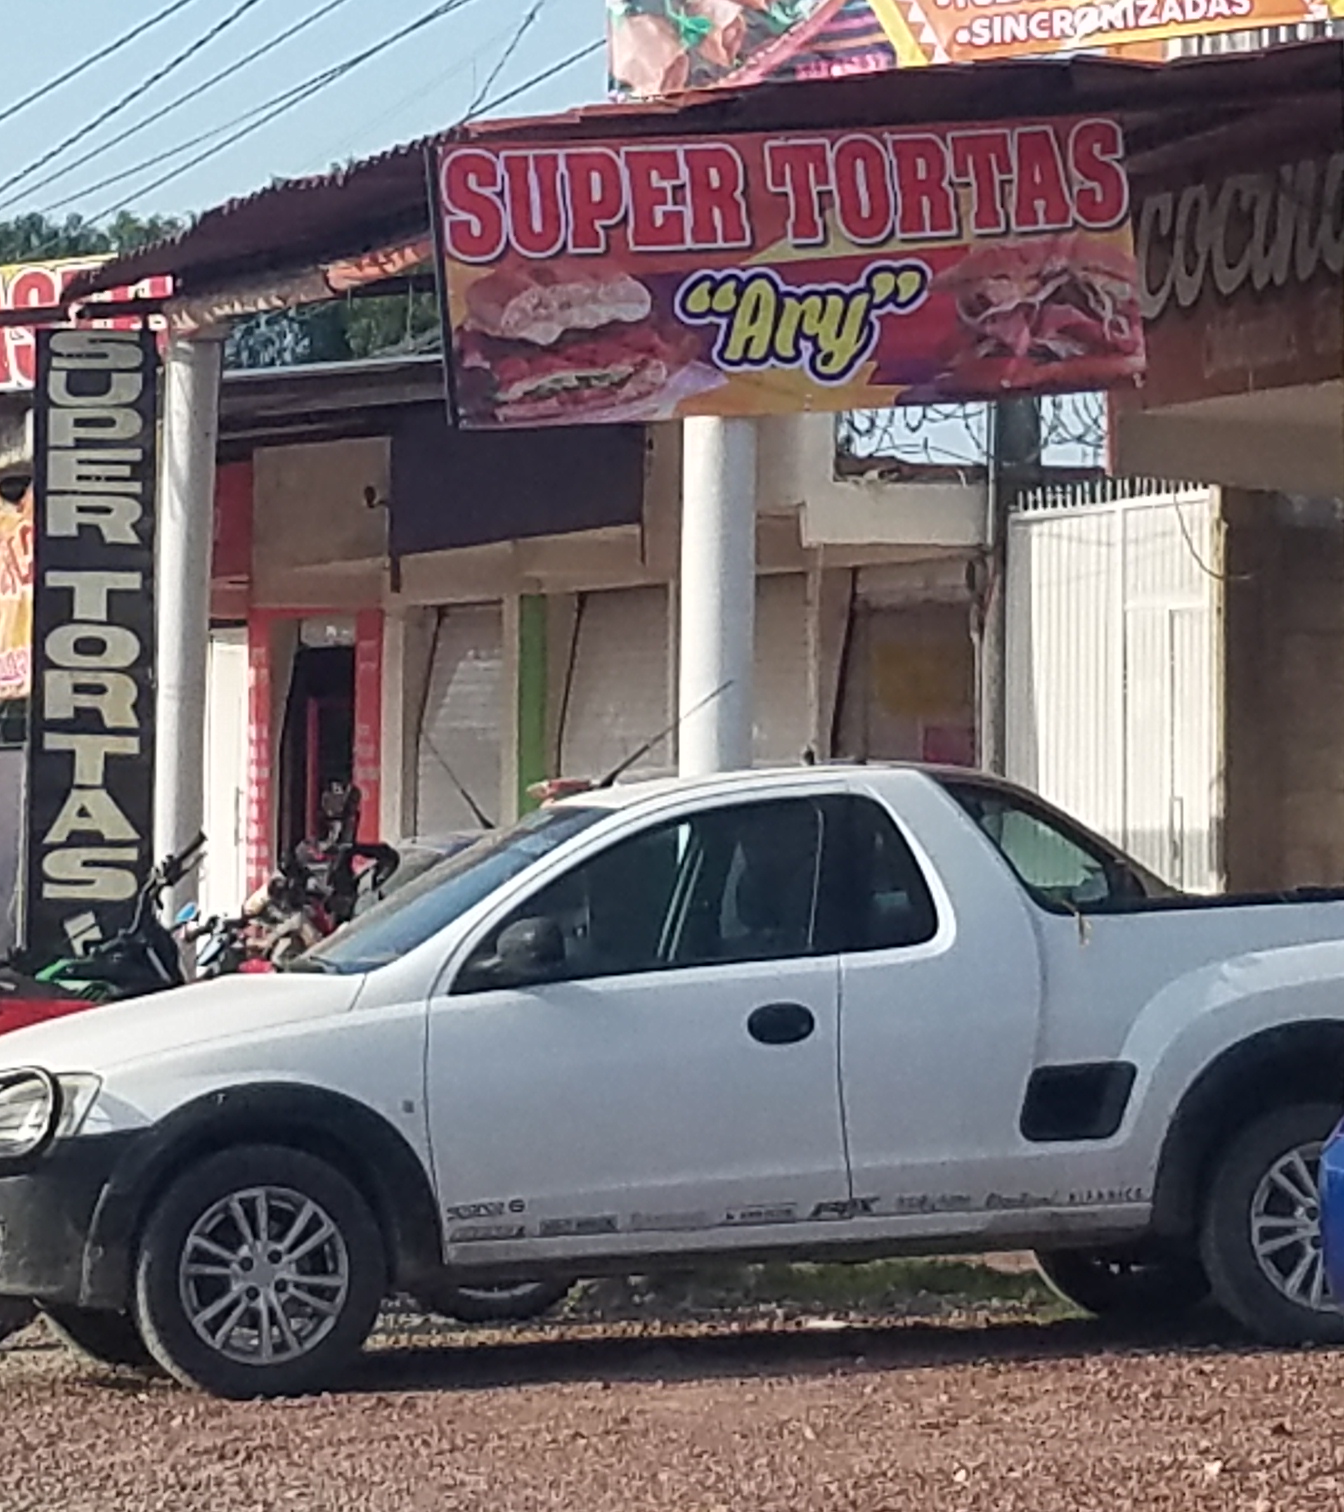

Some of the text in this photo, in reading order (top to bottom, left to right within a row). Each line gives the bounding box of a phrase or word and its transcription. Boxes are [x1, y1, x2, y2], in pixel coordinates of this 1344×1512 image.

[443, 119, 1129, 262] SUPER TORTAS
[43, 330, 144, 544] SUPER
[42, 571, 143, 901] TORTAS
